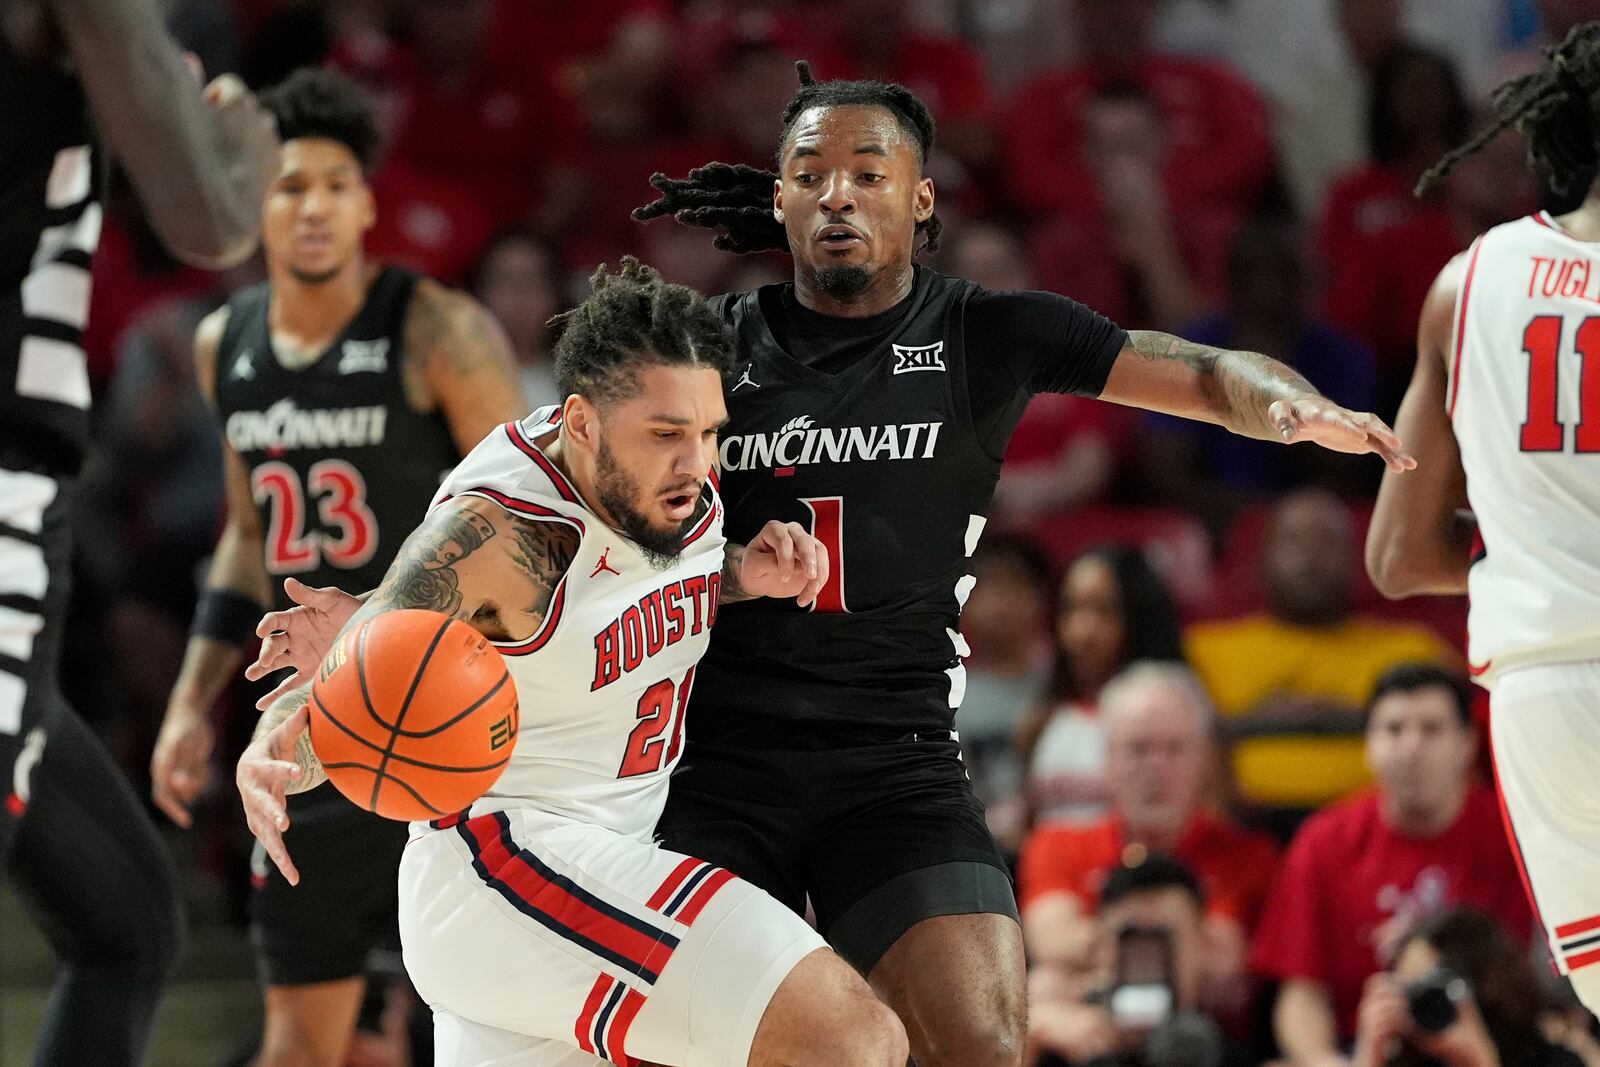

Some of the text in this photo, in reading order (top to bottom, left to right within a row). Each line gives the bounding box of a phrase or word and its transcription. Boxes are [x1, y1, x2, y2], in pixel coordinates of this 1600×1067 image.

[1529, 256, 1600, 304] TUGL
[1520, 314, 1600, 454] 11
[719, 418, 943, 471] CINCINNATI
[251, 460, 380, 575] 23
[796, 495, 853, 614] 1
[590, 570, 722, 692] HOUSTO
[616, 664, 696, 780] 21
